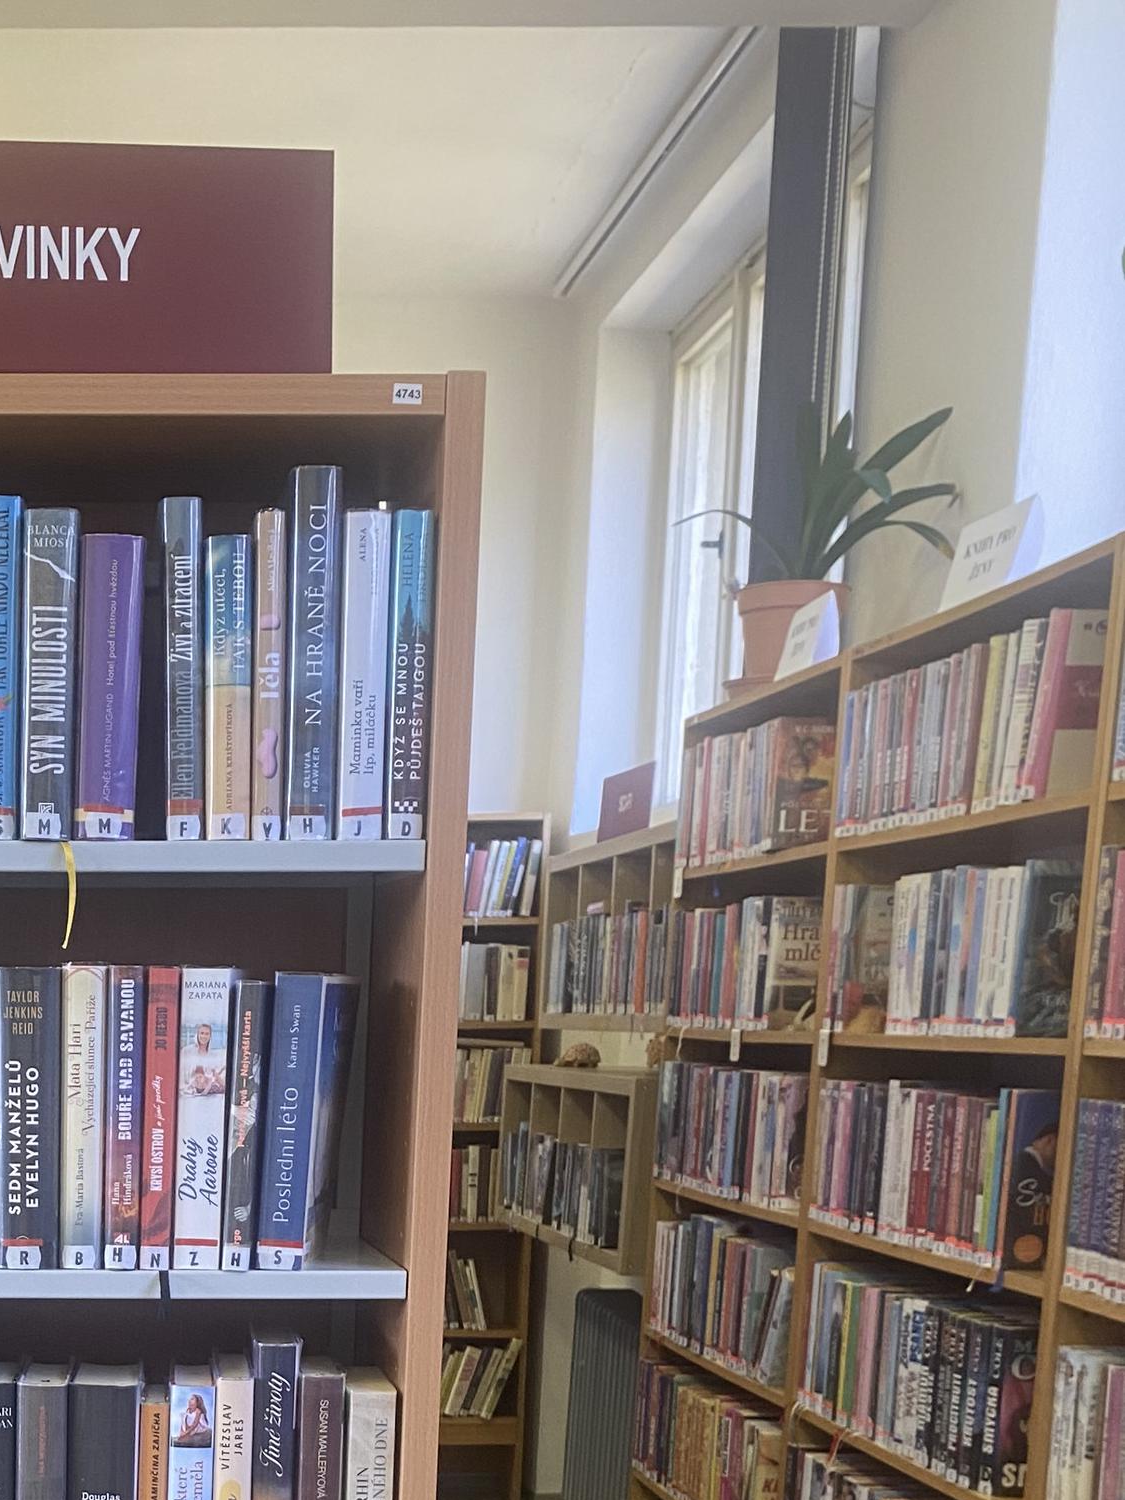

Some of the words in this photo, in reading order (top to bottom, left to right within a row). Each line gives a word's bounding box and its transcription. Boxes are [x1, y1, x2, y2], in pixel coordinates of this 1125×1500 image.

[395, 389, 421, 399] 4743
[308, 504, 326, 572] NOCI
[305, 584, 324, 676] HRANĚ
[31, 606, 68, 721] MINULOSTI
[304, 689, 323, 725] NA
[30, 735, 65, 774] SYN
[304, 751, 312, 788] OLIVIA
[312, 747, 320, 793] HAWKER
[120, 979, 135, 1051] SAVANOU
[289, 1004, 301, 1033] Swan
[119, 1058, 133, 1089] NAD
[287, 1037, 298, 1068] Karen
[4, 1060, 21, 1153] MANŽELŮ
[25, 1067, 39, 1125] HUGO
[115, 1095, 132, 1140] BOUŘE
[277, 1087, 299, 1131] léto
[8, 1158, 21, 1215] SEDM
[26, 1134, 39, 1208] EVELYN
[178, 1138, 202, 1201] Drahý
[203, 1135, 218, 1206] Aarone
[273, 1139, 295, 1222] Poslední
[264, 1372, 290, 1427] životy
[259, 1431, 282, 1477] Jiné
